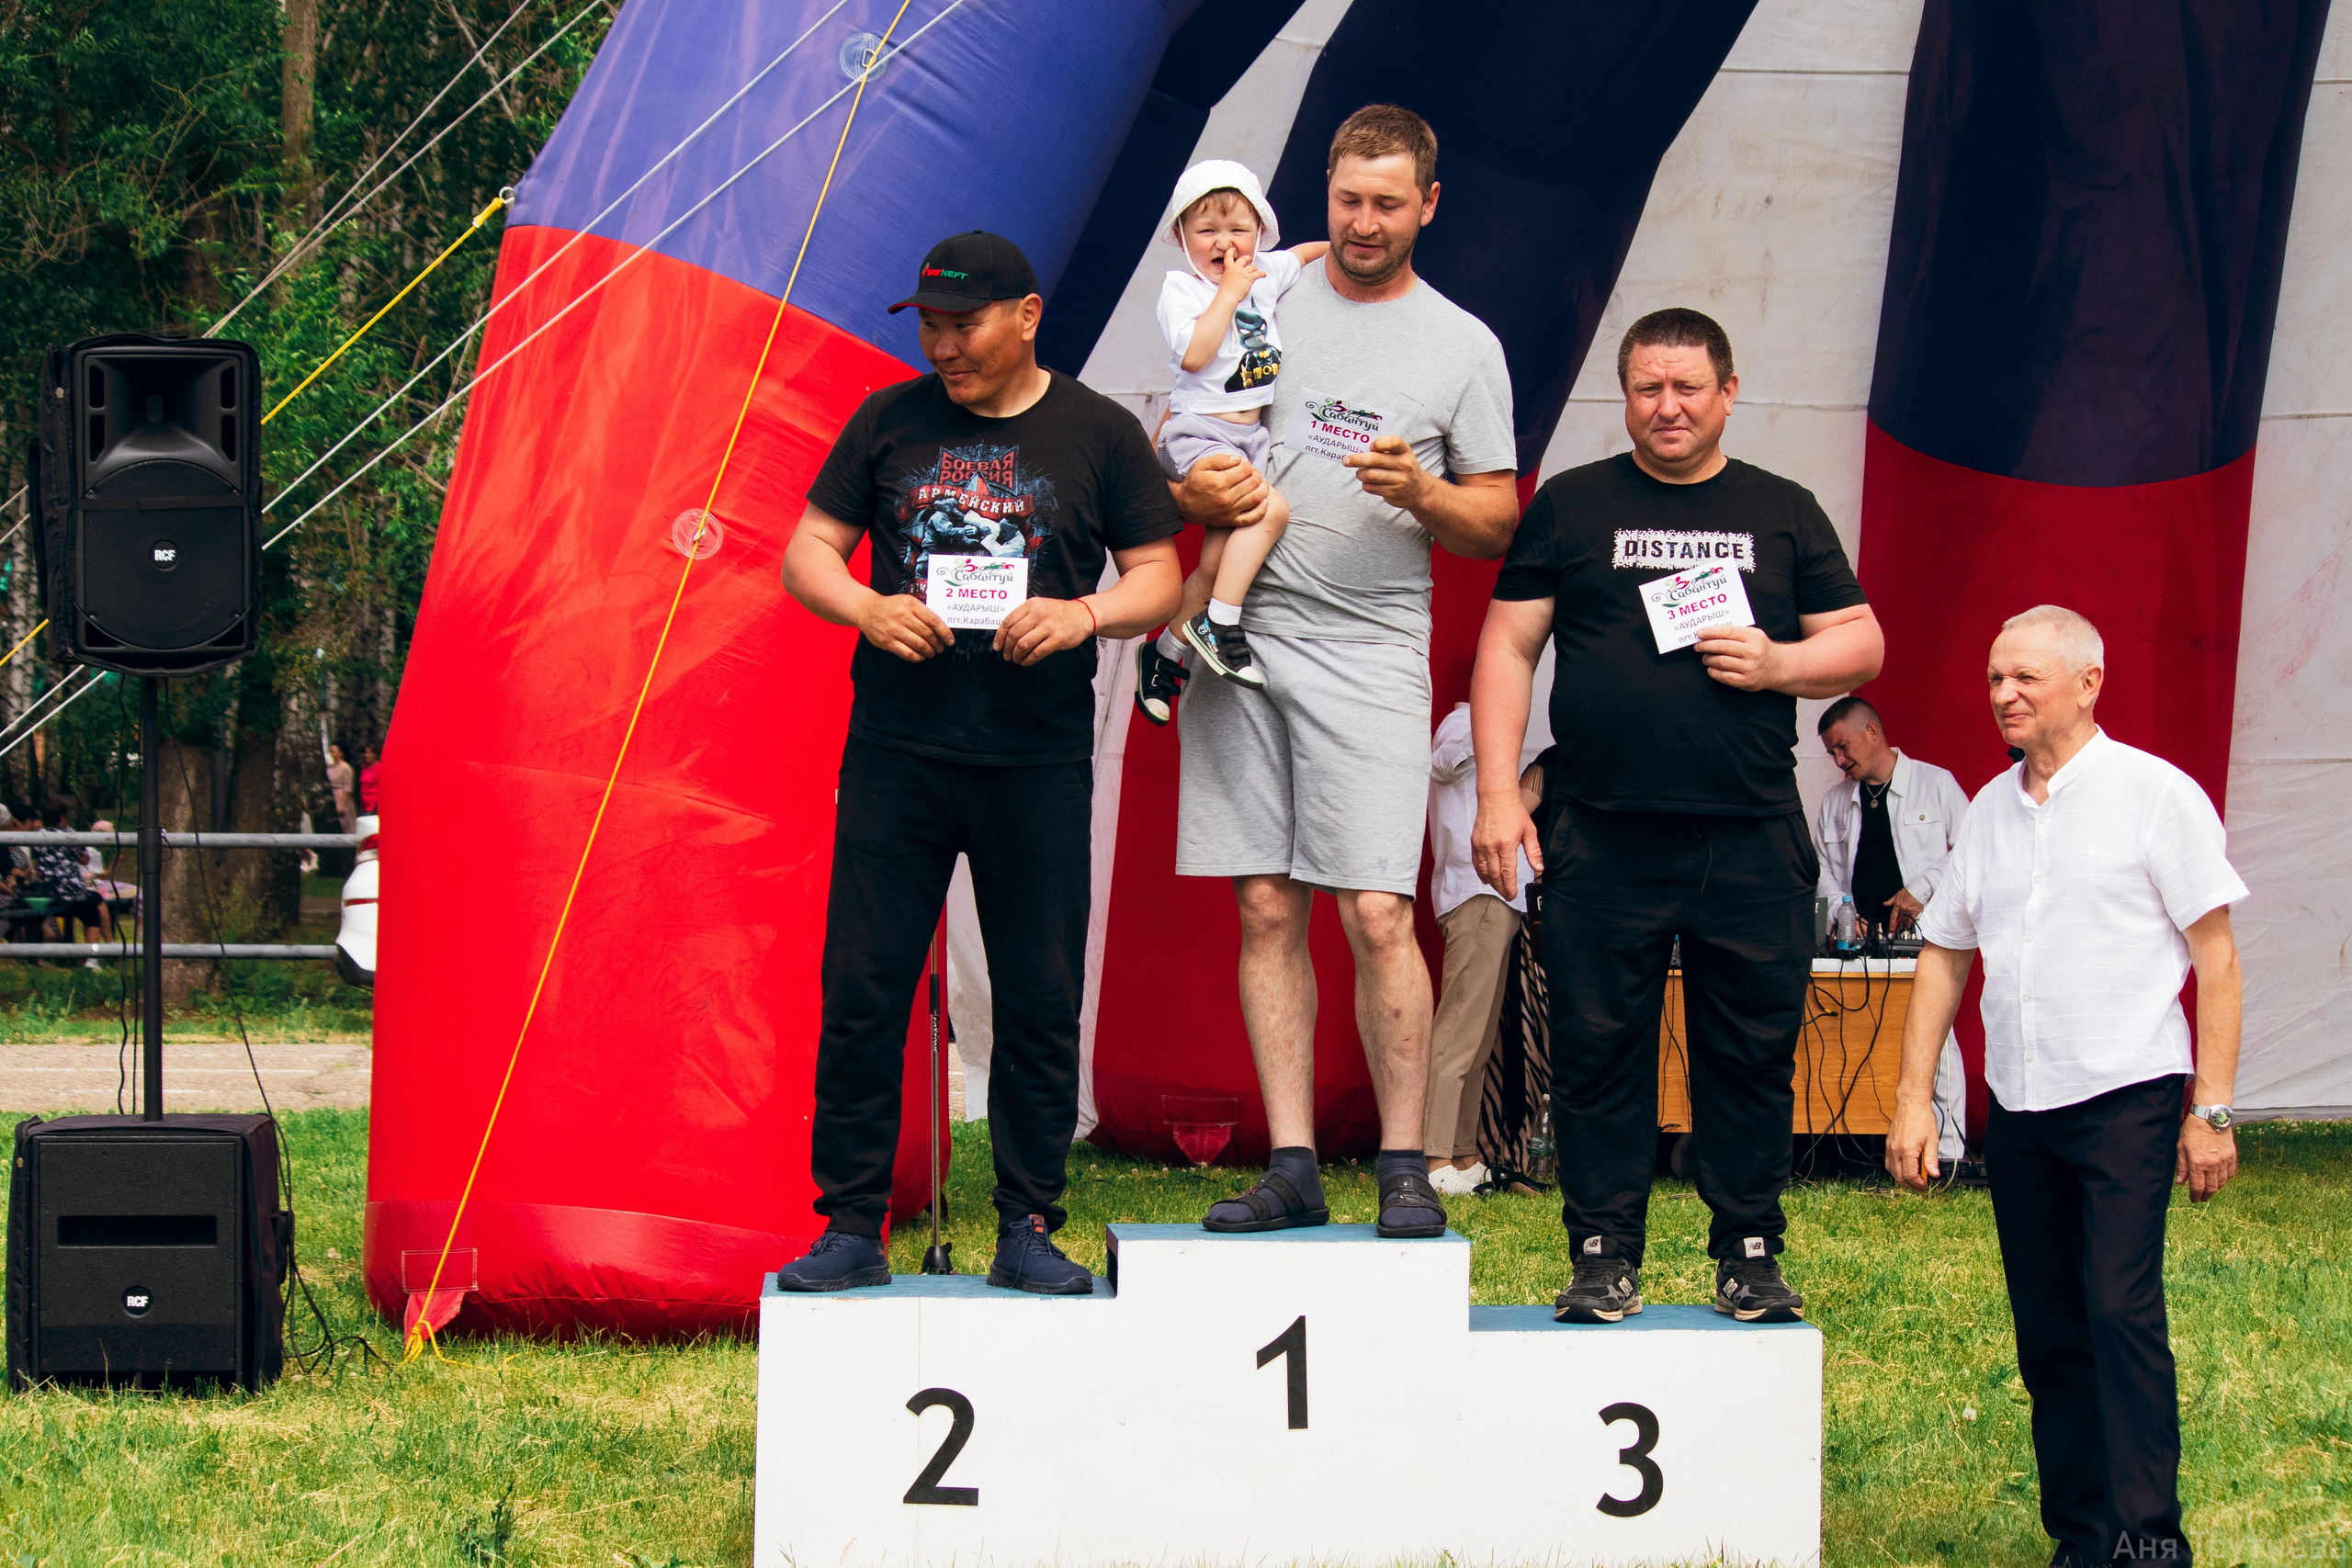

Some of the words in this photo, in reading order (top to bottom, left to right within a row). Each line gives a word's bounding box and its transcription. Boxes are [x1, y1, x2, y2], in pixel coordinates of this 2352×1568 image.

[1322, 406, 1379, 432] Сабантуй
[1311, 420, 1317, 429] 1
[1321, 423, 1371, 444] МЕСТО
[1307, 434, 1364, 454] «АУДАРЫШ»
[942, 451, 1014, 470] БОЕВАЯ
[918, 488, 1025, 513] АРМЕЙСКИЙ
[154, 549, 175, 561] RCF
[1624, 539, 1744, 559] DISTANCE
[955, 570, 1014, 585] Сабантуй
[1668, 576, 1728, 602] Сабантуй
[945, 588, 954, 598] 2
[958, 589, 1008, 600] МЕСТО
[946, 604, 1005, 613] «АУДАРЫШ»
[1667, 609, 1676, 620] 3
[1679, 593, 1727, 616] МЕСТО
[1673, 609, 1730, 632] «АУДАРЫШ»
[127, 1295, 149, 1306] RCF
[1255, 1314, 1309, 1430] 1
[902, 1387, 979, 1506] 2
[1596, 1402, 1664, 1517] 3
